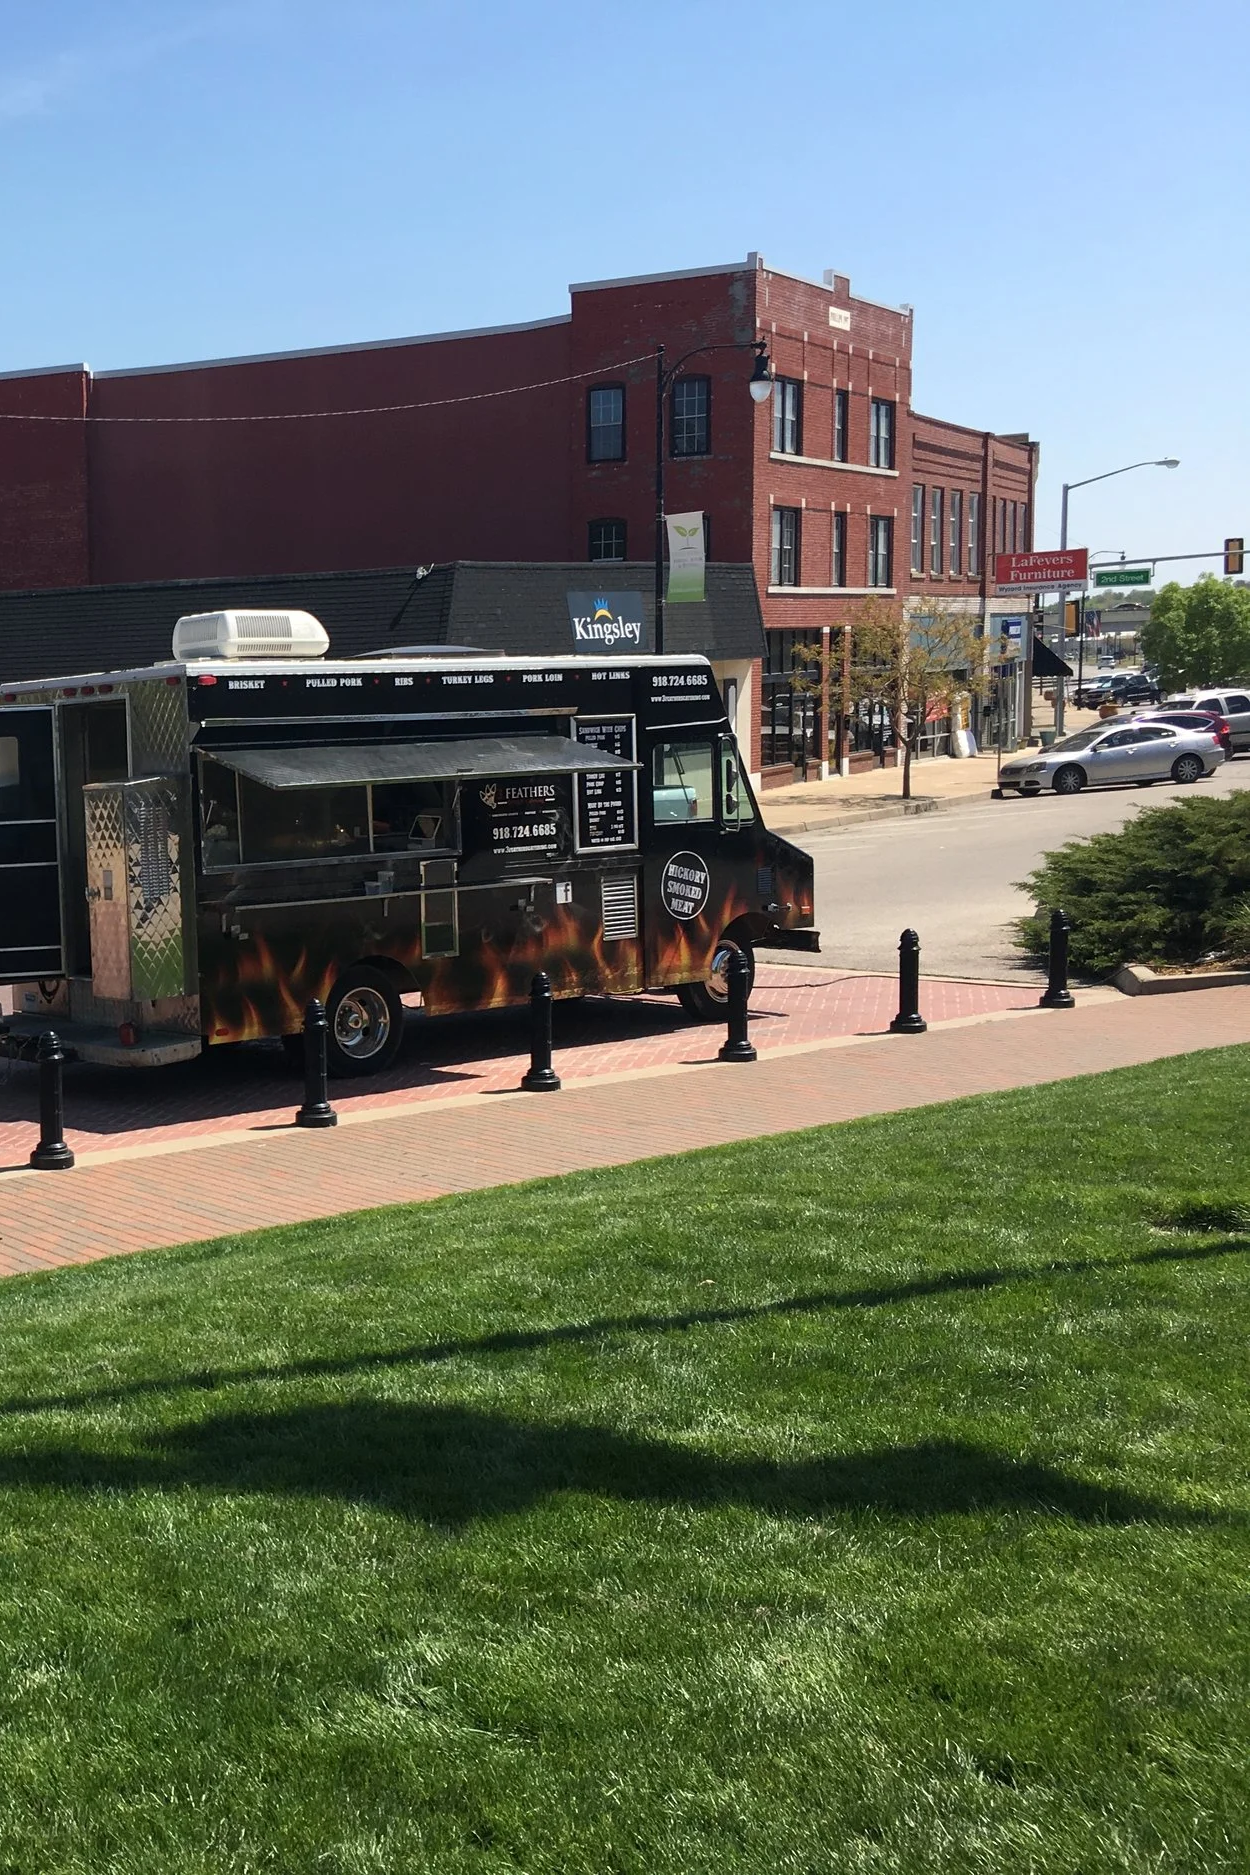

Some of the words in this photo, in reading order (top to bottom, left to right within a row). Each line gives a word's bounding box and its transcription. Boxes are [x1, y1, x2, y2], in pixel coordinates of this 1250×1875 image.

[1011, 554, 1073, 568] LaFevers
[1010, 567, 1075, 581] Furniture
[1101, 575, 1117, 583] 2nd
[1119, 574, 1144, 582] Street
[1023, 584, 1055, 592] Insurance
[1057, 582, 1082, 590] Agency
[572, 615, 641, 646] Kingsley
[228, 680, 265, 690] BRISKET
[306, 678, 338, 688] PULLED
[339, 677, 362, 687] PORK
[395, 677, 414, 686] RIBS
[441, 675, 472, 685] TURKEY
[474, 674, 494, 684] LEGS
[522, 674, 543, 683] PORK
[545, 673, 563, 682] LOIN
[591, 671, 607, 680] HOT
[608, 671, 630, 680] LINKS
[652, 674, 708, 687] 918.724.6685
[505, 785, 555, 799] FEATHERS
[492, 823, 557, 840] 918.724.6685
[668, 863, 706, 885] HICKORY
[667, 880, 702, 900] SMOKED
[670, 897, 695, 914] MEAT
